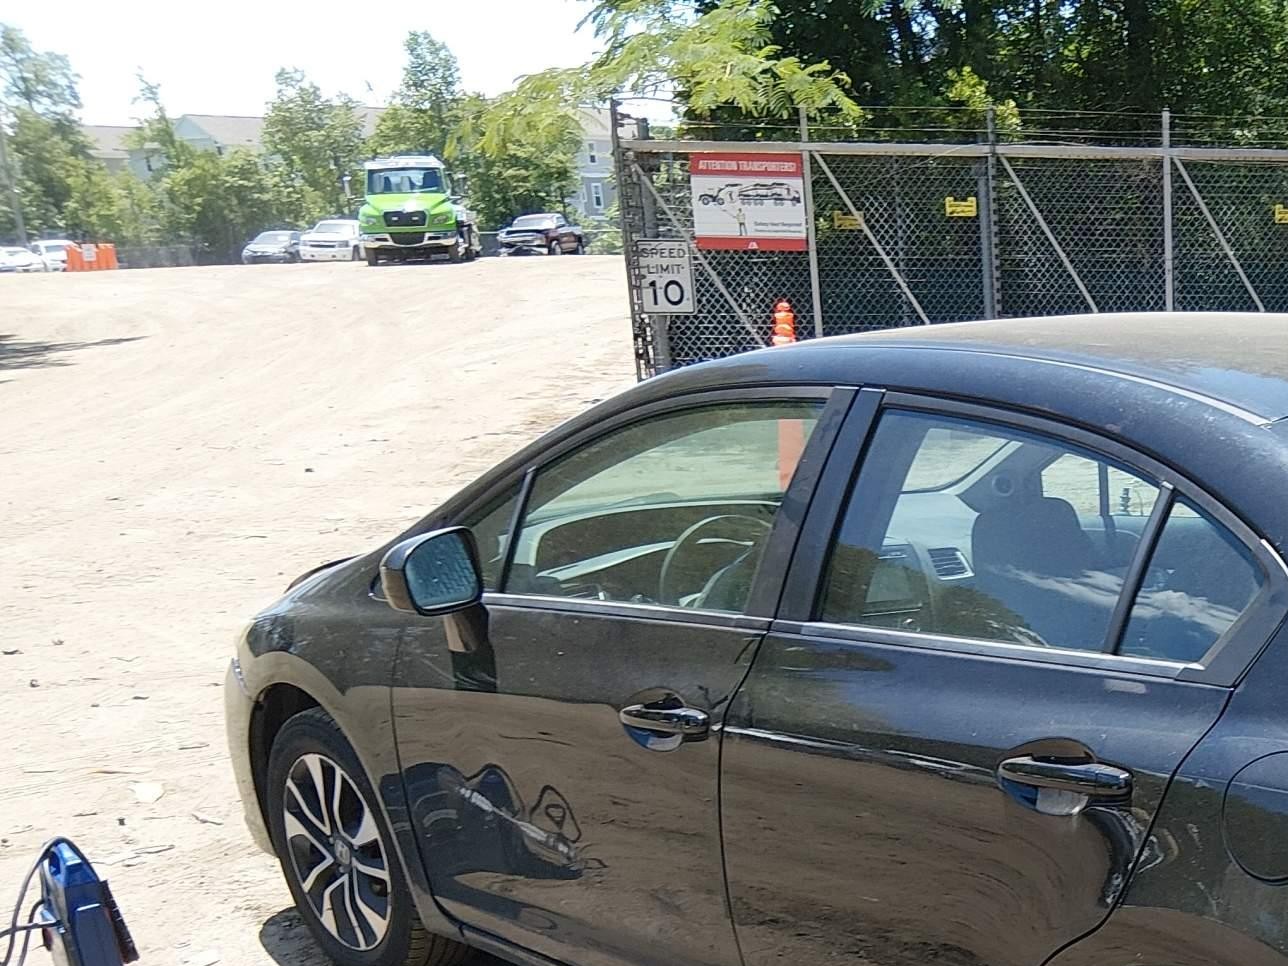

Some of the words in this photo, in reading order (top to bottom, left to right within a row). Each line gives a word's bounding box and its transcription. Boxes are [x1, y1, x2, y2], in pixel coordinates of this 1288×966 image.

[640, 247, 686, 259] SPEED
[647, 263, 682, 274] LIMIT
[648, 279, 685, 306] 10
